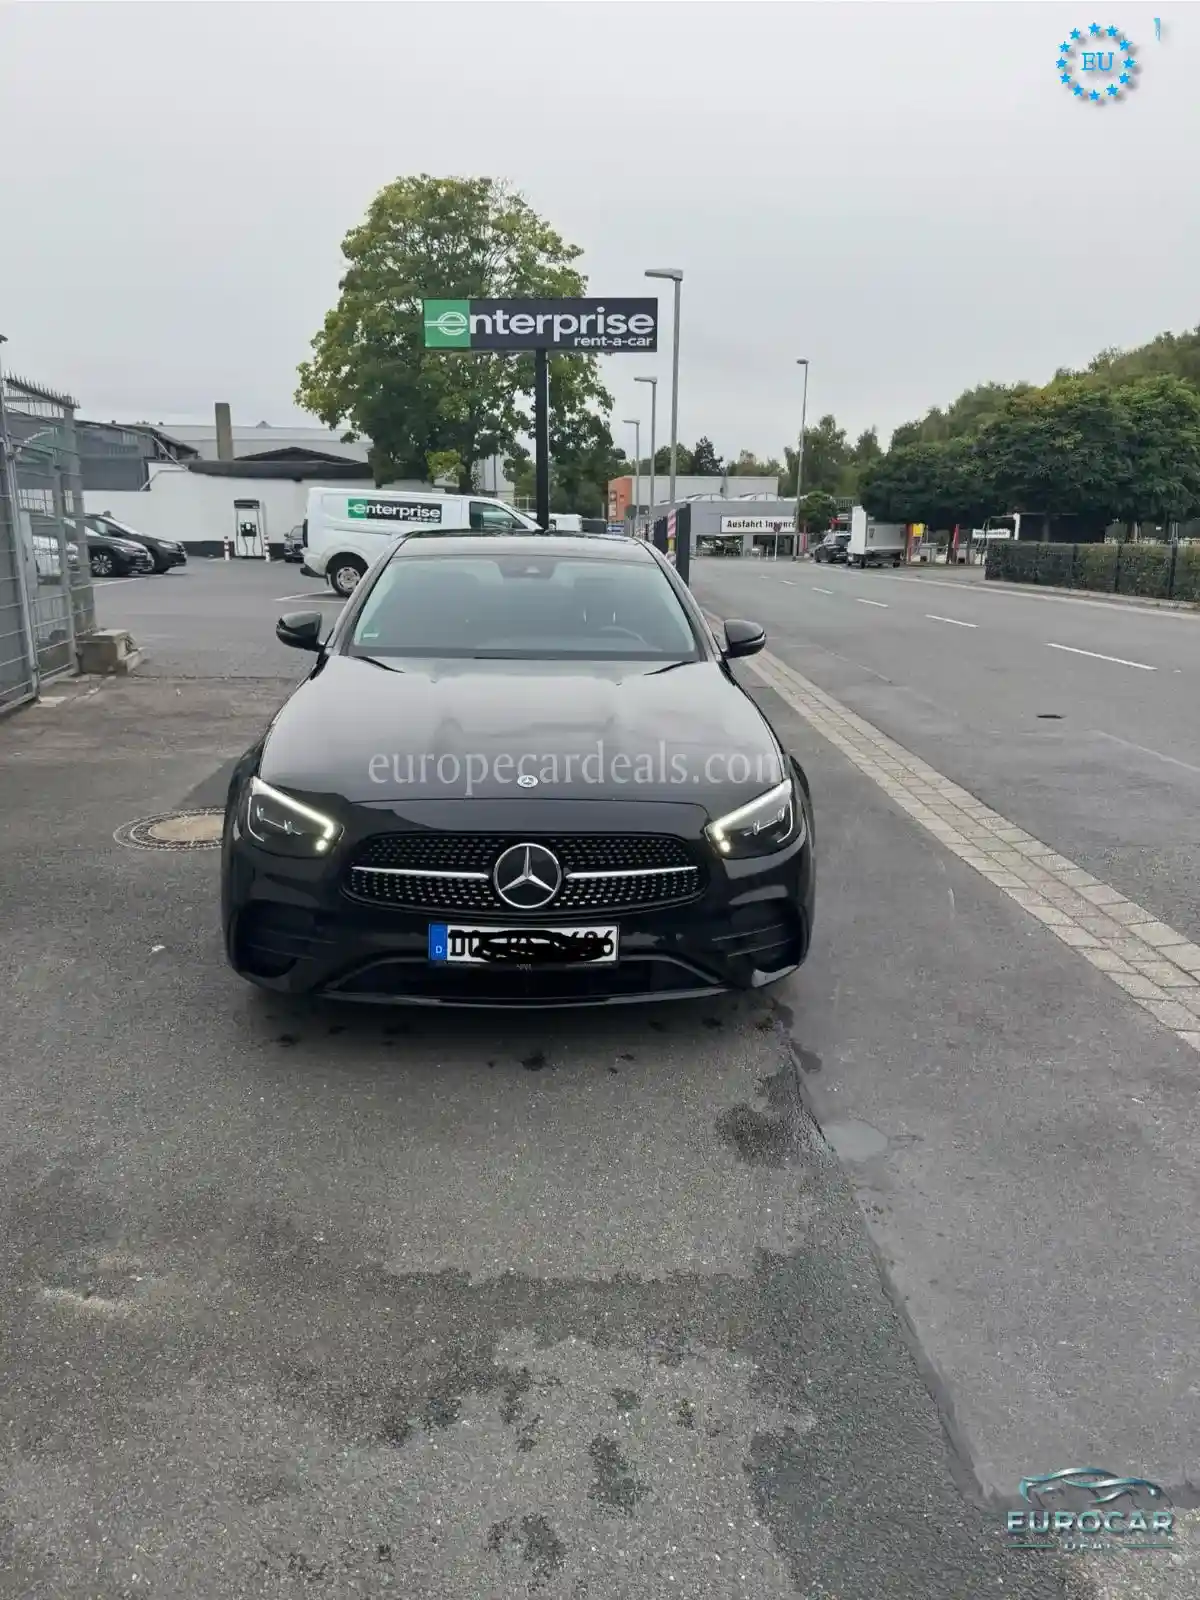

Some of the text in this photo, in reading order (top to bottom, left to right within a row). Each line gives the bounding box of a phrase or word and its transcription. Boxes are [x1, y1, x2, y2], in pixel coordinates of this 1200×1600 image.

[425, 306, 655, 342] enterprise
[574, 336, 653, 347] rent-a-car
[348, 503, 441, 519] enterprise
[727, 520, 763, 529] Ausfahrt
[435, 945, 443, 954] D
